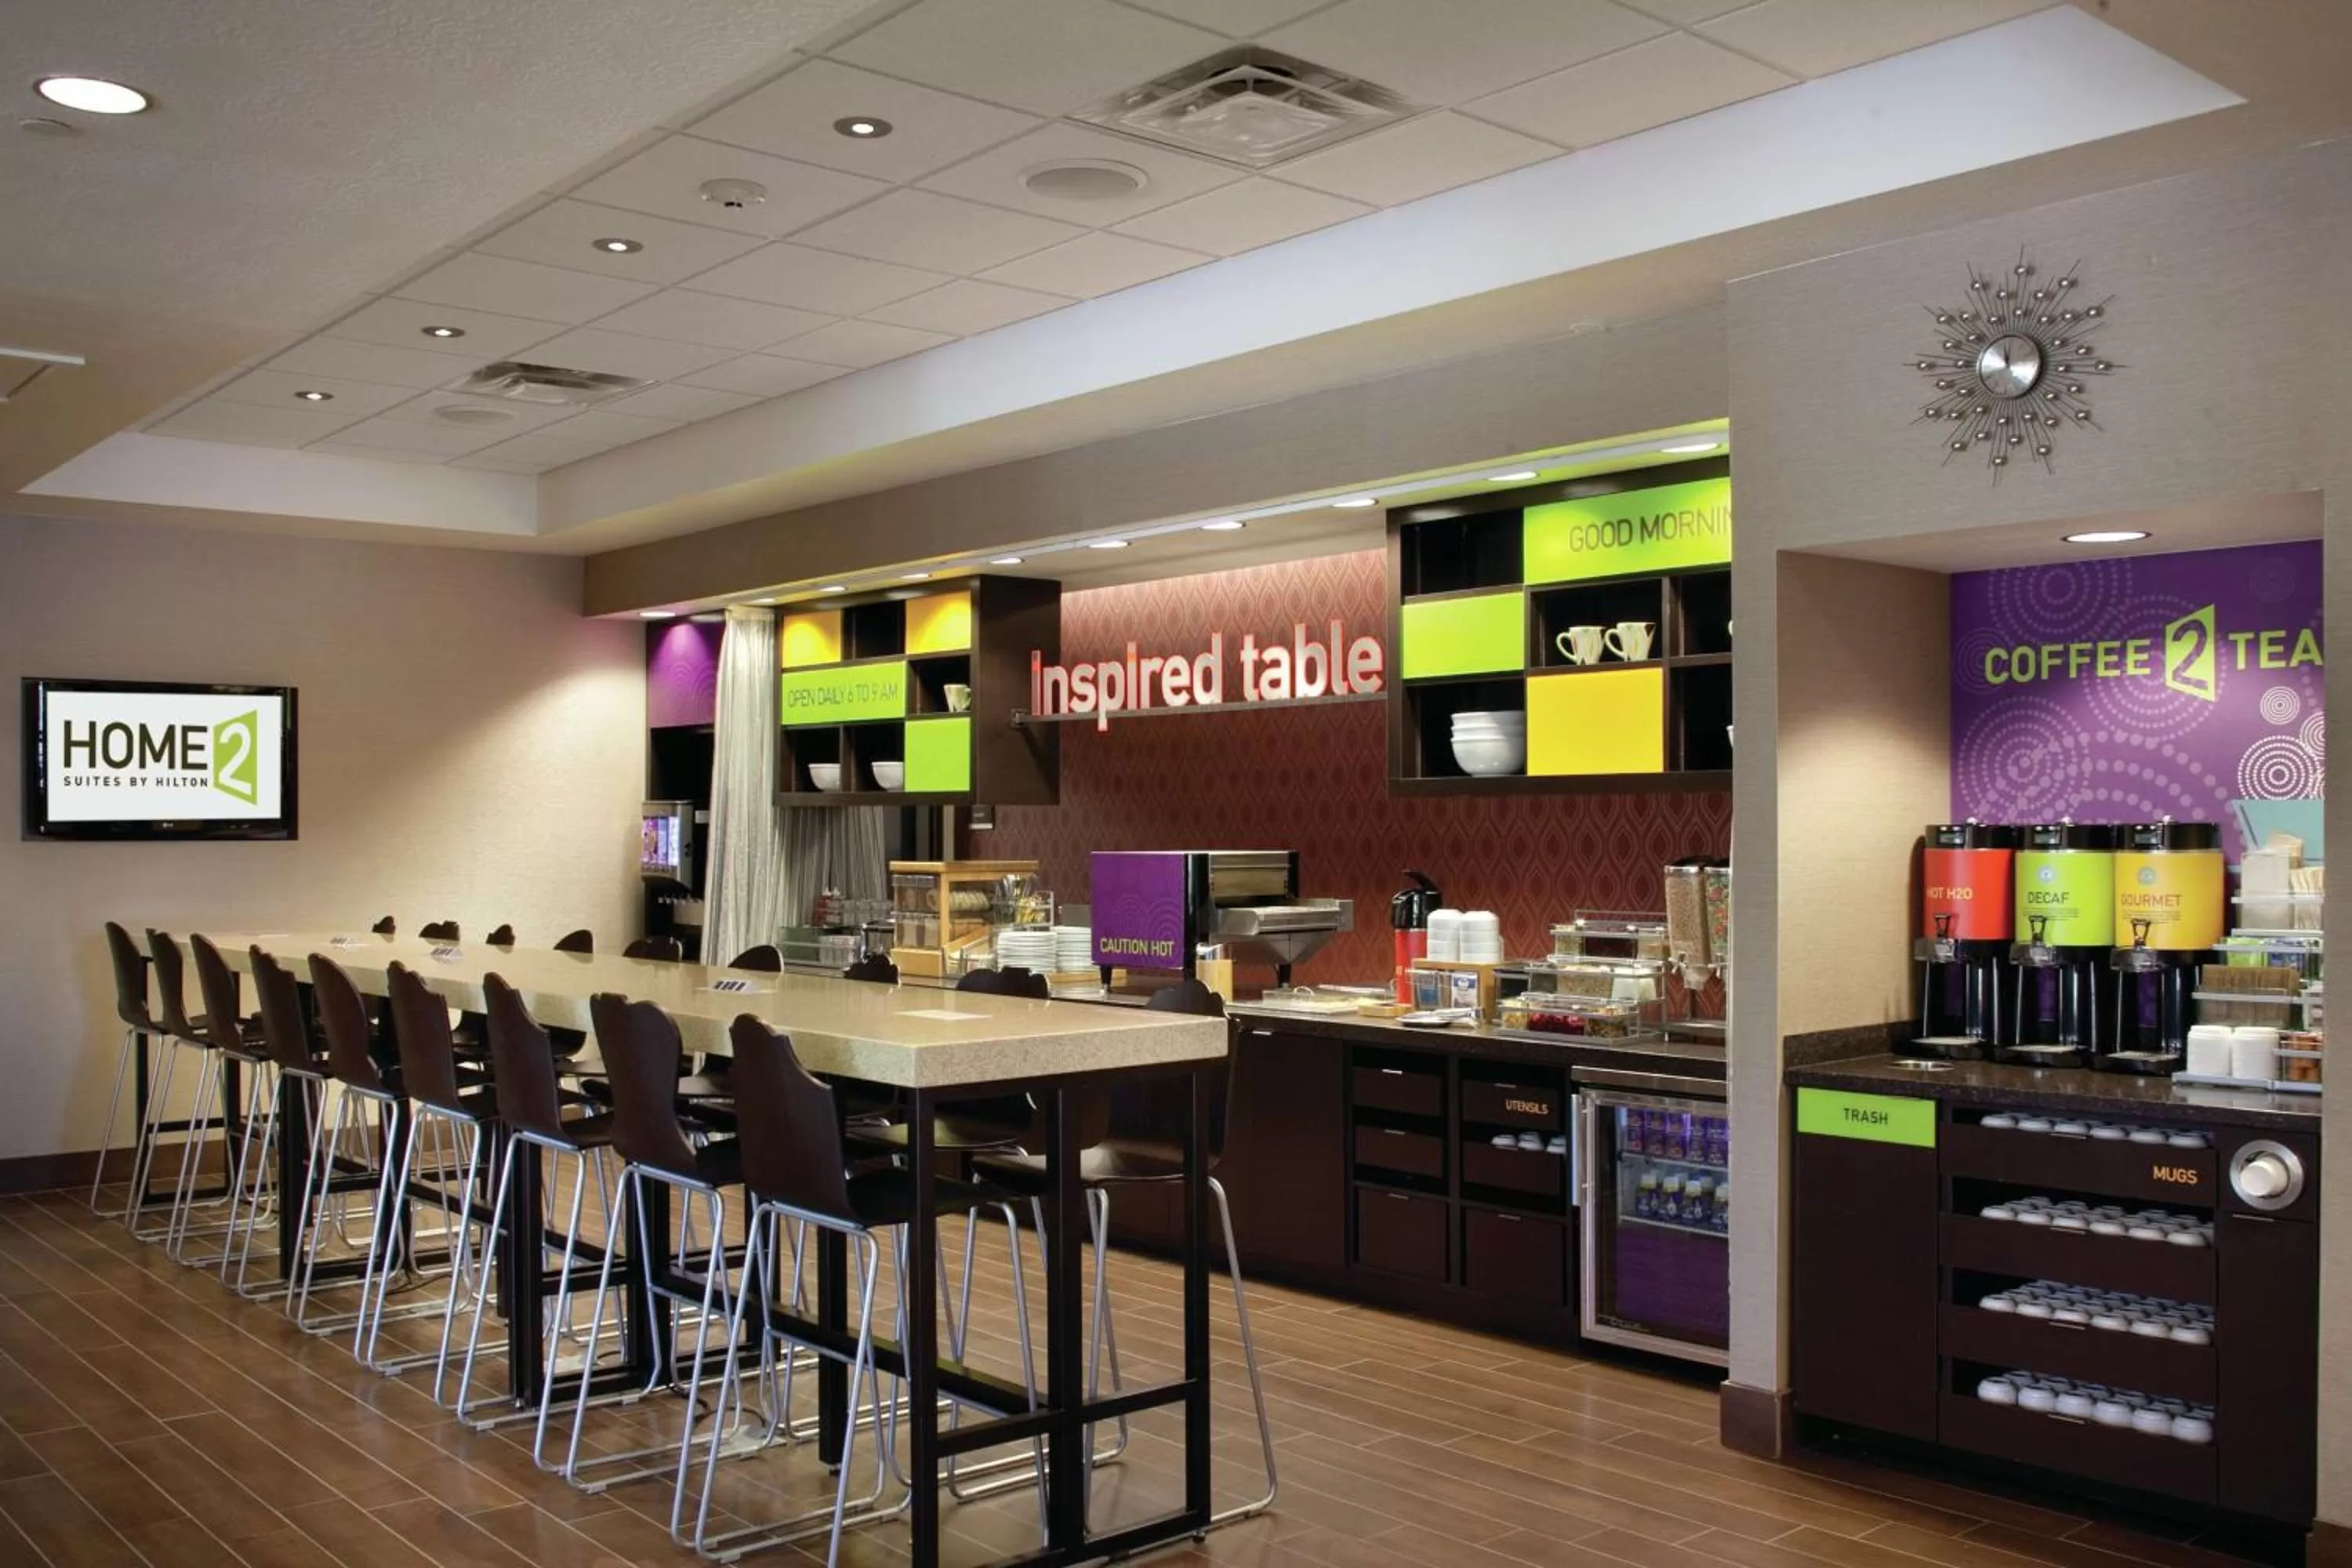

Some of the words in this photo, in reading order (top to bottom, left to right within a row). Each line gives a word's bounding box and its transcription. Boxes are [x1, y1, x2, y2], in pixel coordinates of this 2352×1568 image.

[1569, 518, 1633, 552] GOOD
[1984, 638, 2151, 684] COFFEE
[2170, 617, 2211, 691] 2
[2228, 627, 2324, 671] TEA
[1031, 632, 1223, 732] inspired
[1240, 619, 1384, 702] table
[788, 688, 815, 707] OPEN
[818, 684, 846, 705] DAILY
[848, 684, 854, 703] 6
[855, 683, 870, 702] TO
[880, 681, 898, 702] AM
[63, 775, 122, 787] SUITES
[129, 776, 148, 787] BY
[155, 776, 209, 788] HILTON
[2027, 891, 2071, 905] DECAF
[2120, 893, 2183, 908] GOURMET
[1099, 937, 1149, 956] CAUTION
[1150, 940, 1174, 957] HOT
[1504, 1098, 1550, 1115] UTENSILS
[1843, 1107, 1889, 1125] TRASH
[2152, 1165, 2198, 1185] MUGS
